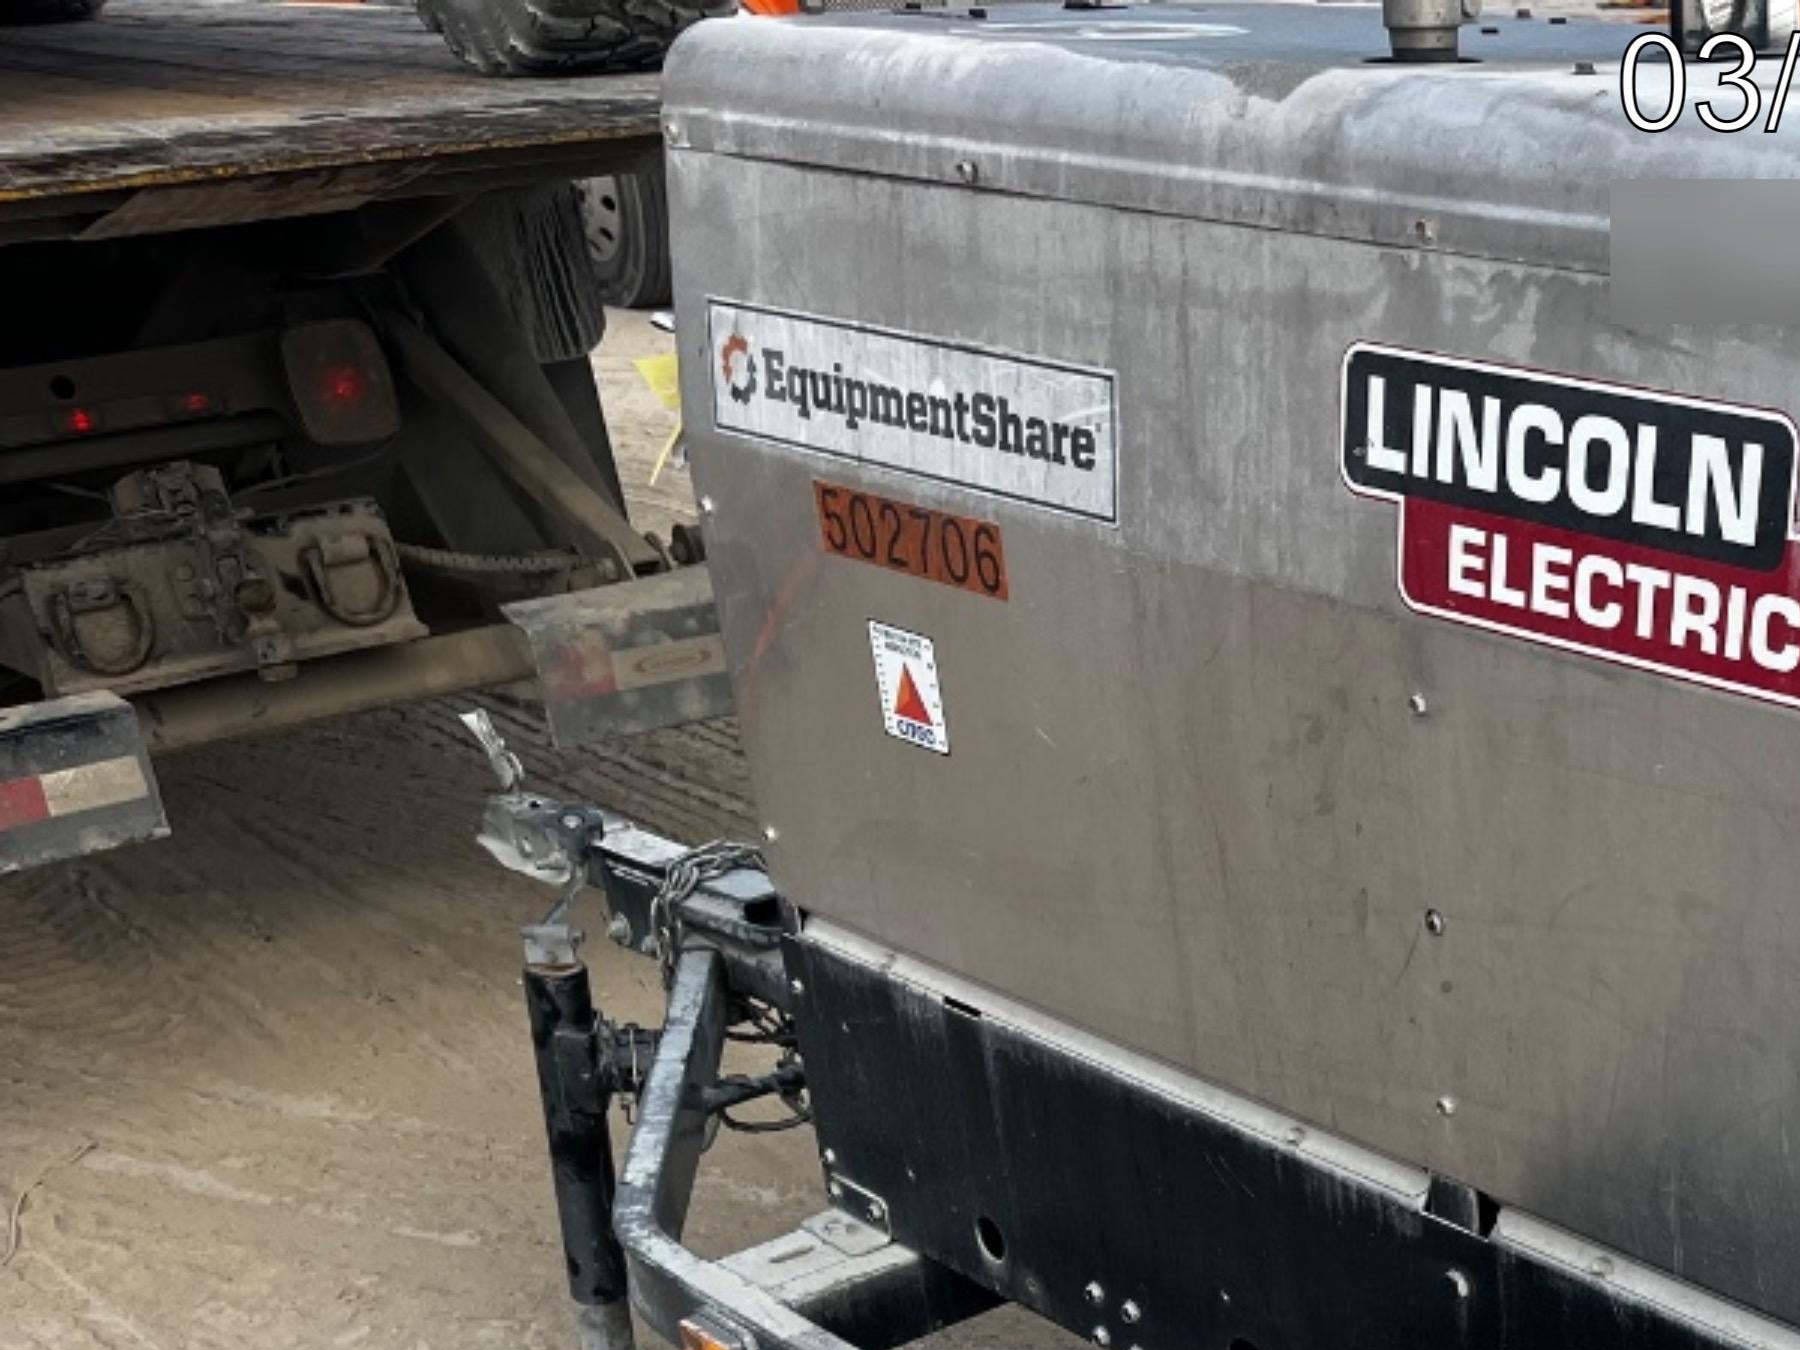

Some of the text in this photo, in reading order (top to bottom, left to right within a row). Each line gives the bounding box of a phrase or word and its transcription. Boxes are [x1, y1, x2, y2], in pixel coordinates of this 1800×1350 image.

[762, 348, 1097, 471] EquipmentShare
[1366, 375, 1765, 547] LINCOLN
[822, 488, 1001, 593] 502706
